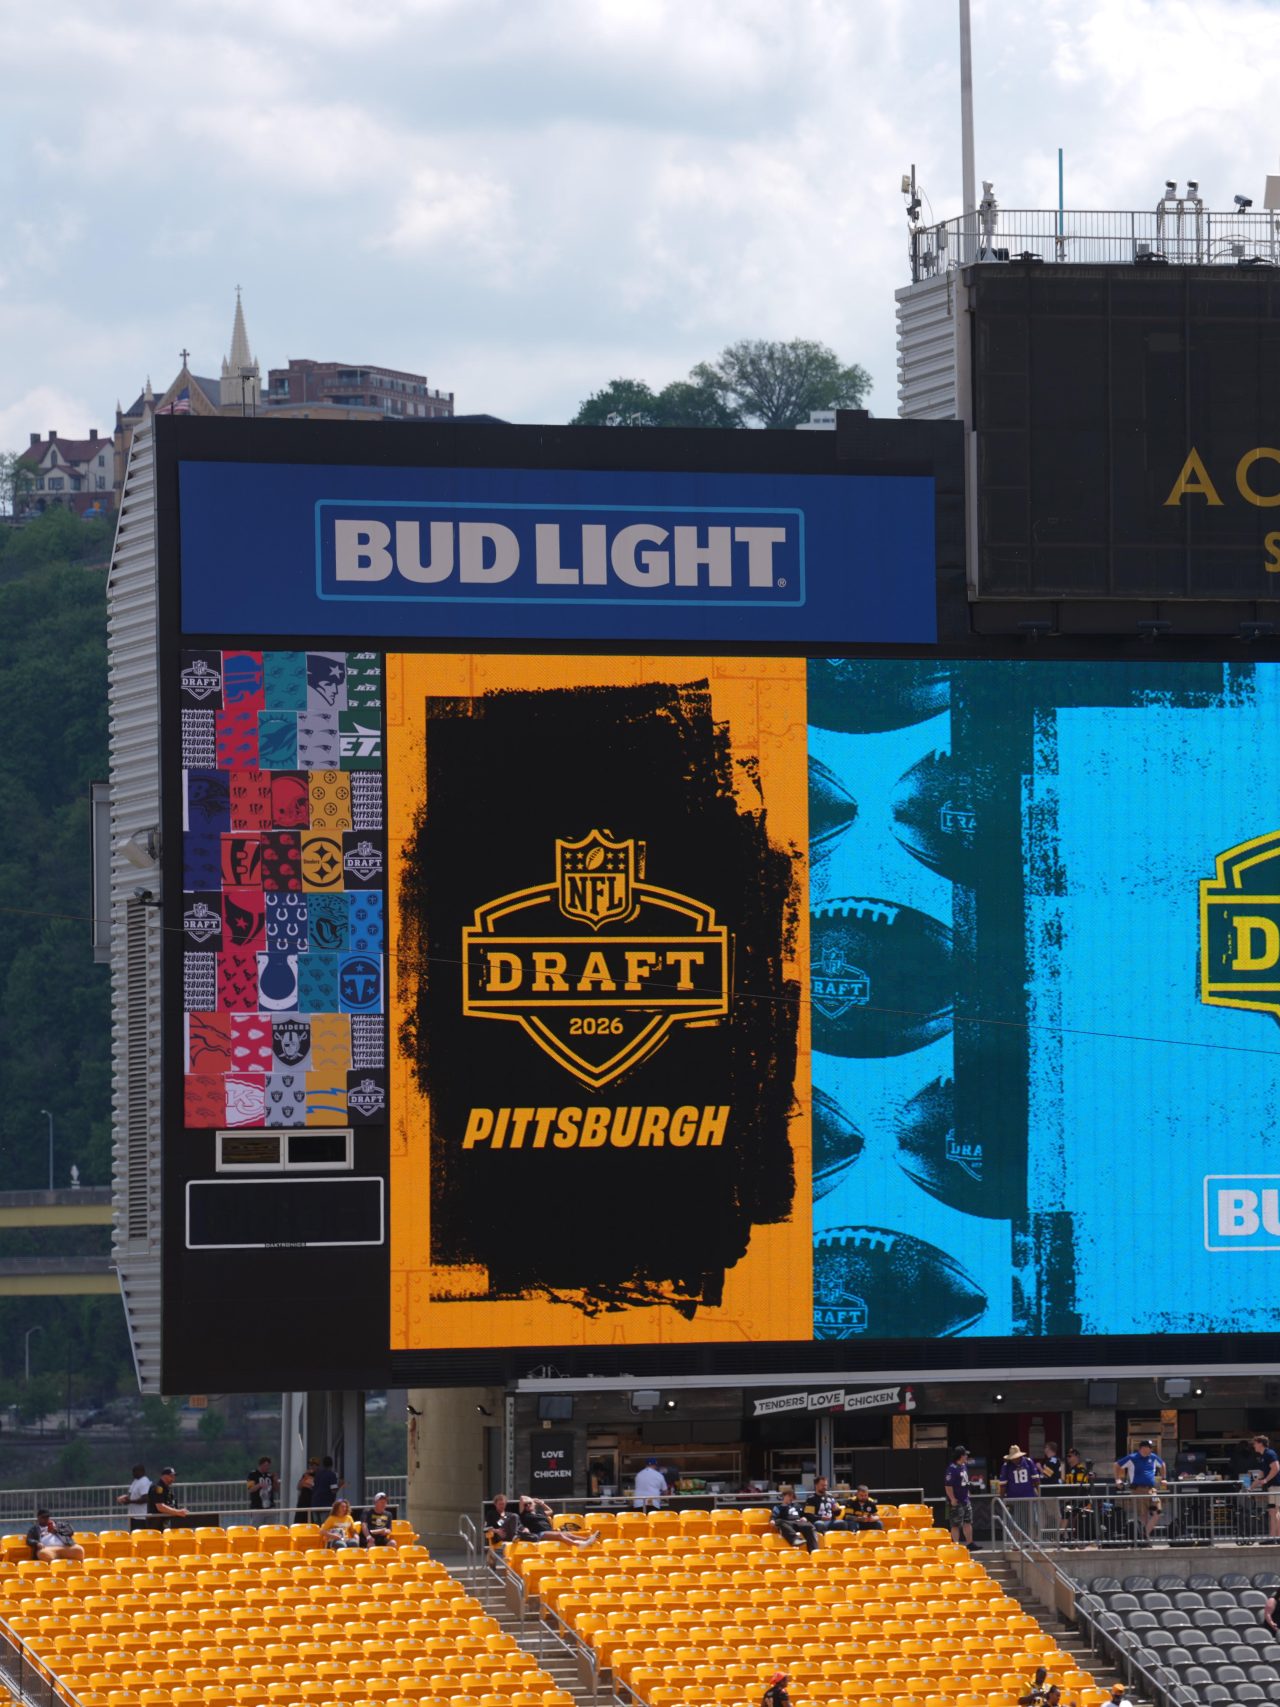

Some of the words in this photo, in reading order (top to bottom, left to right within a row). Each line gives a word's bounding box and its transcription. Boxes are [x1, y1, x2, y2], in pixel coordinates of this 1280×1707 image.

[335, 519, 520, 584] BUD
[182, 678, 218, 686] DRAFT
[347, 859, 383, 867] DRAFT
[568, 875, 624, 915] NFL
[486, 951, 705, 992] DRAFT
[272, 1023, 310, 1031] RAIDERS
[569, 1017, 624, 1035] 2026
[351, 1095, 384, 1103] DRAFT
[462, 1105, 731, 1149] PITTSBURGH
[758, 1396, 805, 1412] TENDERS
[810, 1392, 841, 1407] LOVE
[847, 1392, 894, 1407] CHICKEN
[541, 1451, 565, 1459] LOVE
[534, 1470, 572, 1478] CHICKEN
[1013, 1469, 1029, 1484] 18
